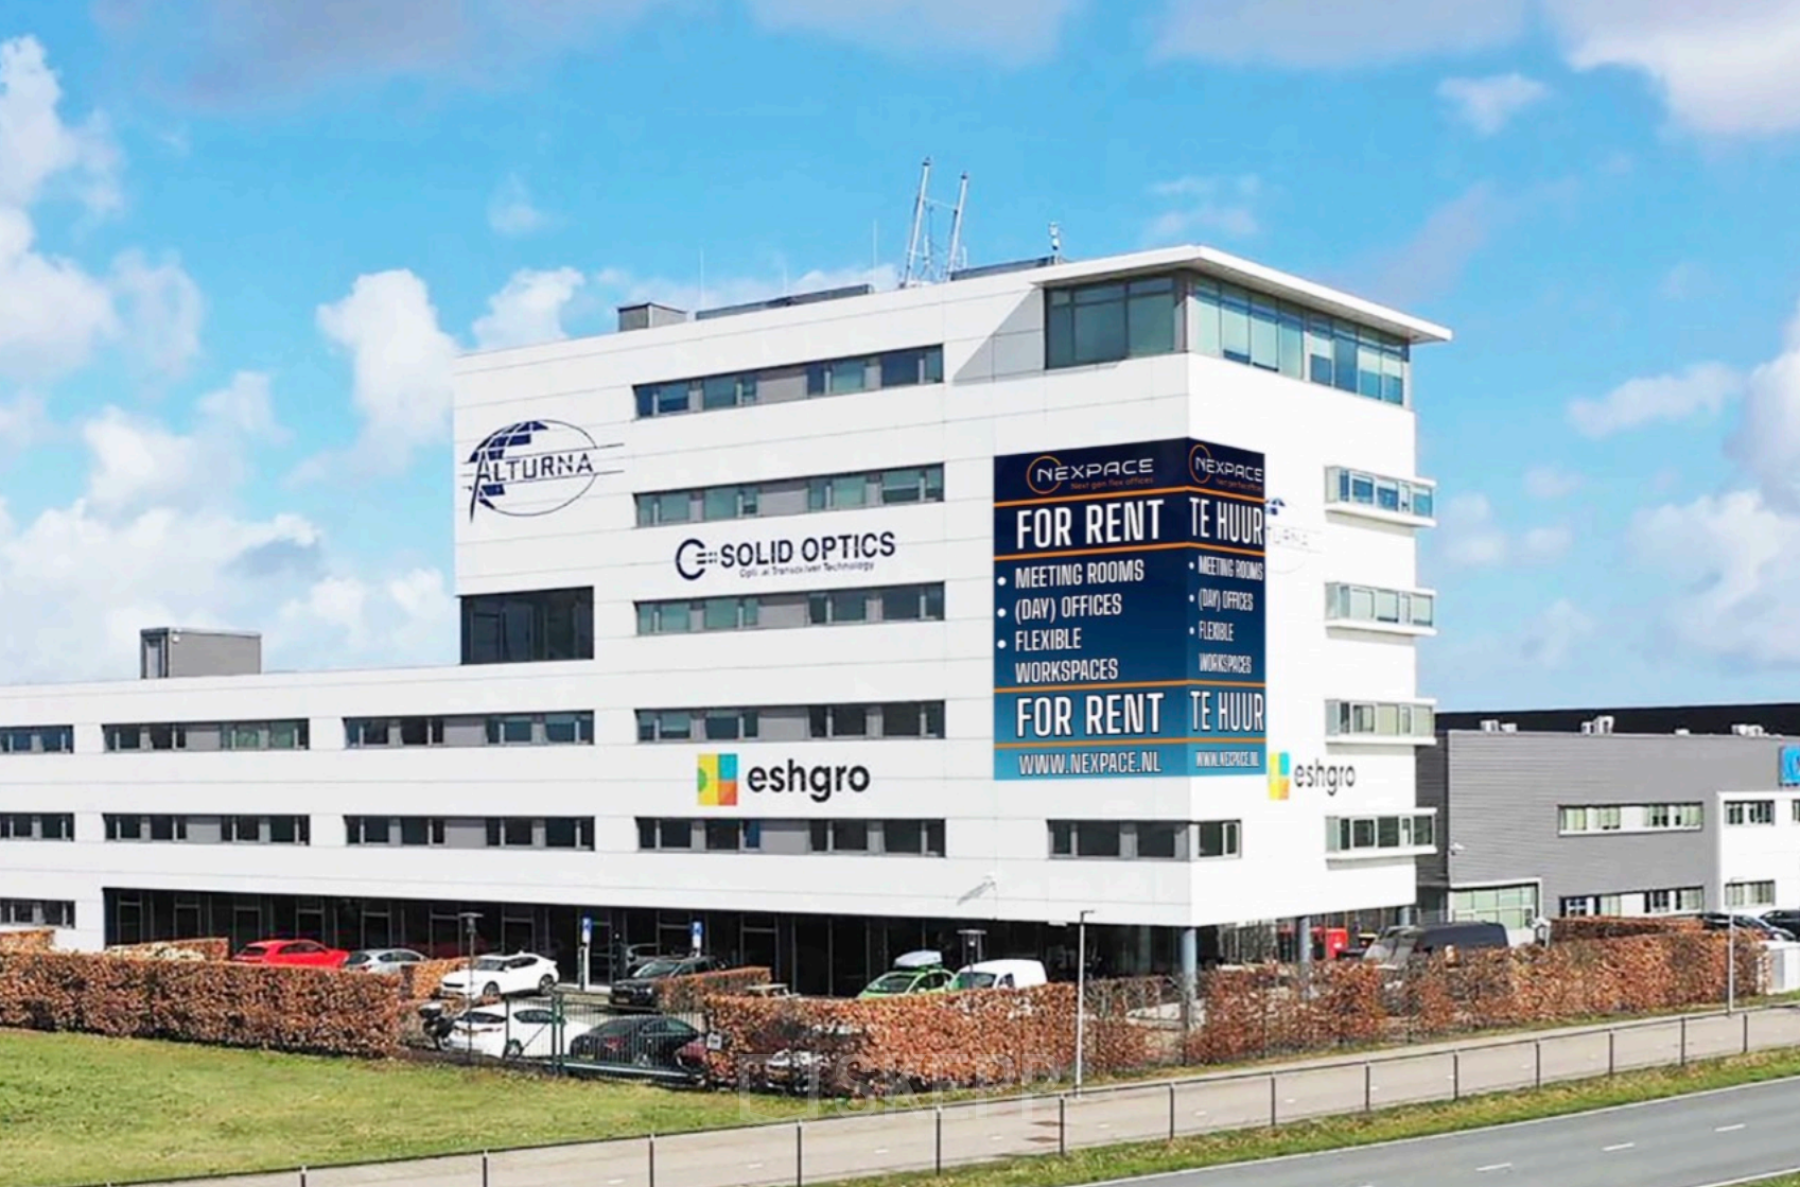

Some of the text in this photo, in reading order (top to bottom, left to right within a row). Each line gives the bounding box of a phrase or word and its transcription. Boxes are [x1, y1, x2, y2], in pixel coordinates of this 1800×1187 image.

[474, 450, 594, 483] ALTURNA
[1037, 458, 1154, 483] NEXPACE
[1195, 455, 1263, 483] NEXPACE
[1017, 499, 1164, 550] FOR RENT
[1189, 497, 1210, 539] TE
[1216, 501, 1263, 546] HUUR
[720, 531, 896, 568] SOLID OPTICS
[1014, 559, 1145, 590] MEETING ROOMS
[1198, 555, 1263, 581] MEETING ROOMS
[1015, 593, 1123, 625] (DAY) OFFICES
[1198, 587, 1254, 612] (DAY) OFFICES
[1015, 627, 1082, 652] FLEXIBLE
[1199, 620, 1234, 642] FLEXIBLE
[1015, 658, 1119, 684] WORKSPACES
[1199, 652, 1252, 674] WORKSPACES
[1017, 692, 1164, 737] FOR RENT
[1190, 691, 1264, 731] TE HUUR
[1019, 751, 1162, 775] WWW.NEXPACE.NL
[1294, 758, 1356, 797] eshgro
[746, 757, 871, 803] eshgro
